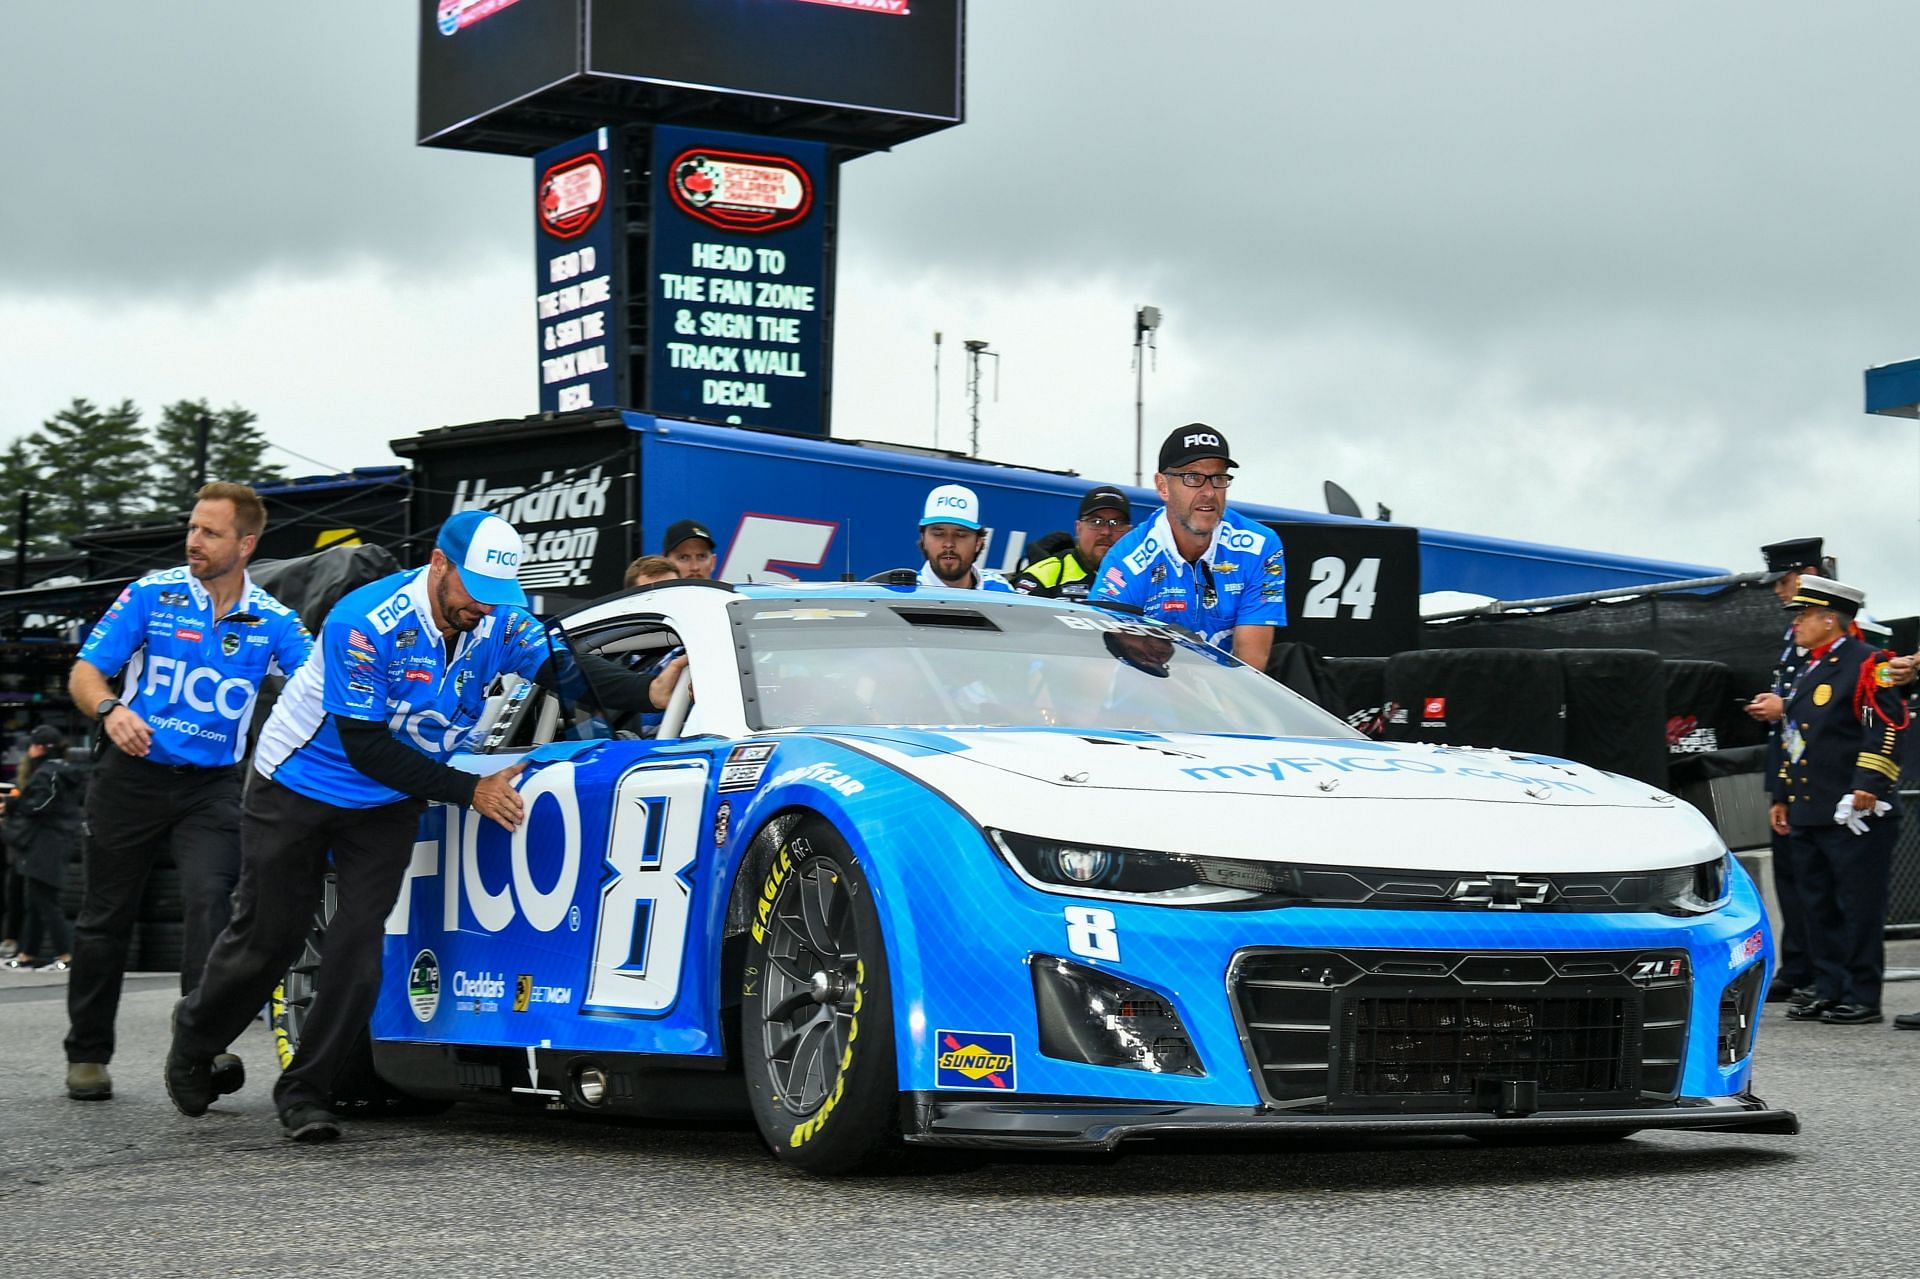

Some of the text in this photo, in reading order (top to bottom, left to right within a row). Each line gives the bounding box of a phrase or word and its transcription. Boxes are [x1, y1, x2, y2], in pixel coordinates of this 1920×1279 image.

[691, 242, 786, 275] HEAD TO
[659, 273, 815, 312] THE FAN ZONE
[674, 308, 800, 344] & SIGN THE
[666, 341, 807, 378] TRACK WALL
[702, 379, 772, 409] DECAL
[1183, 433, 1220, 448] FICO
[936, 496, 968, 509] FICO
[485, 549, 518, 567] FICO
[1302, 556, 1381, 621] 24
[376, 593, 411, 627] FICO
[143, 655, 256, 720] FICO
[149, 714, 227, 743] myFICO.com
[1178, 756, 1597, 796] myFICO.com
[583, 757, 711, 1015] 8
[751, 843, 792, 945] EAGLE
[1063, 905, 1121, 963] 8
[453, 970, 506, 998] Cheddar's
[942, 1053, 1009, 1070] SUNOCO
